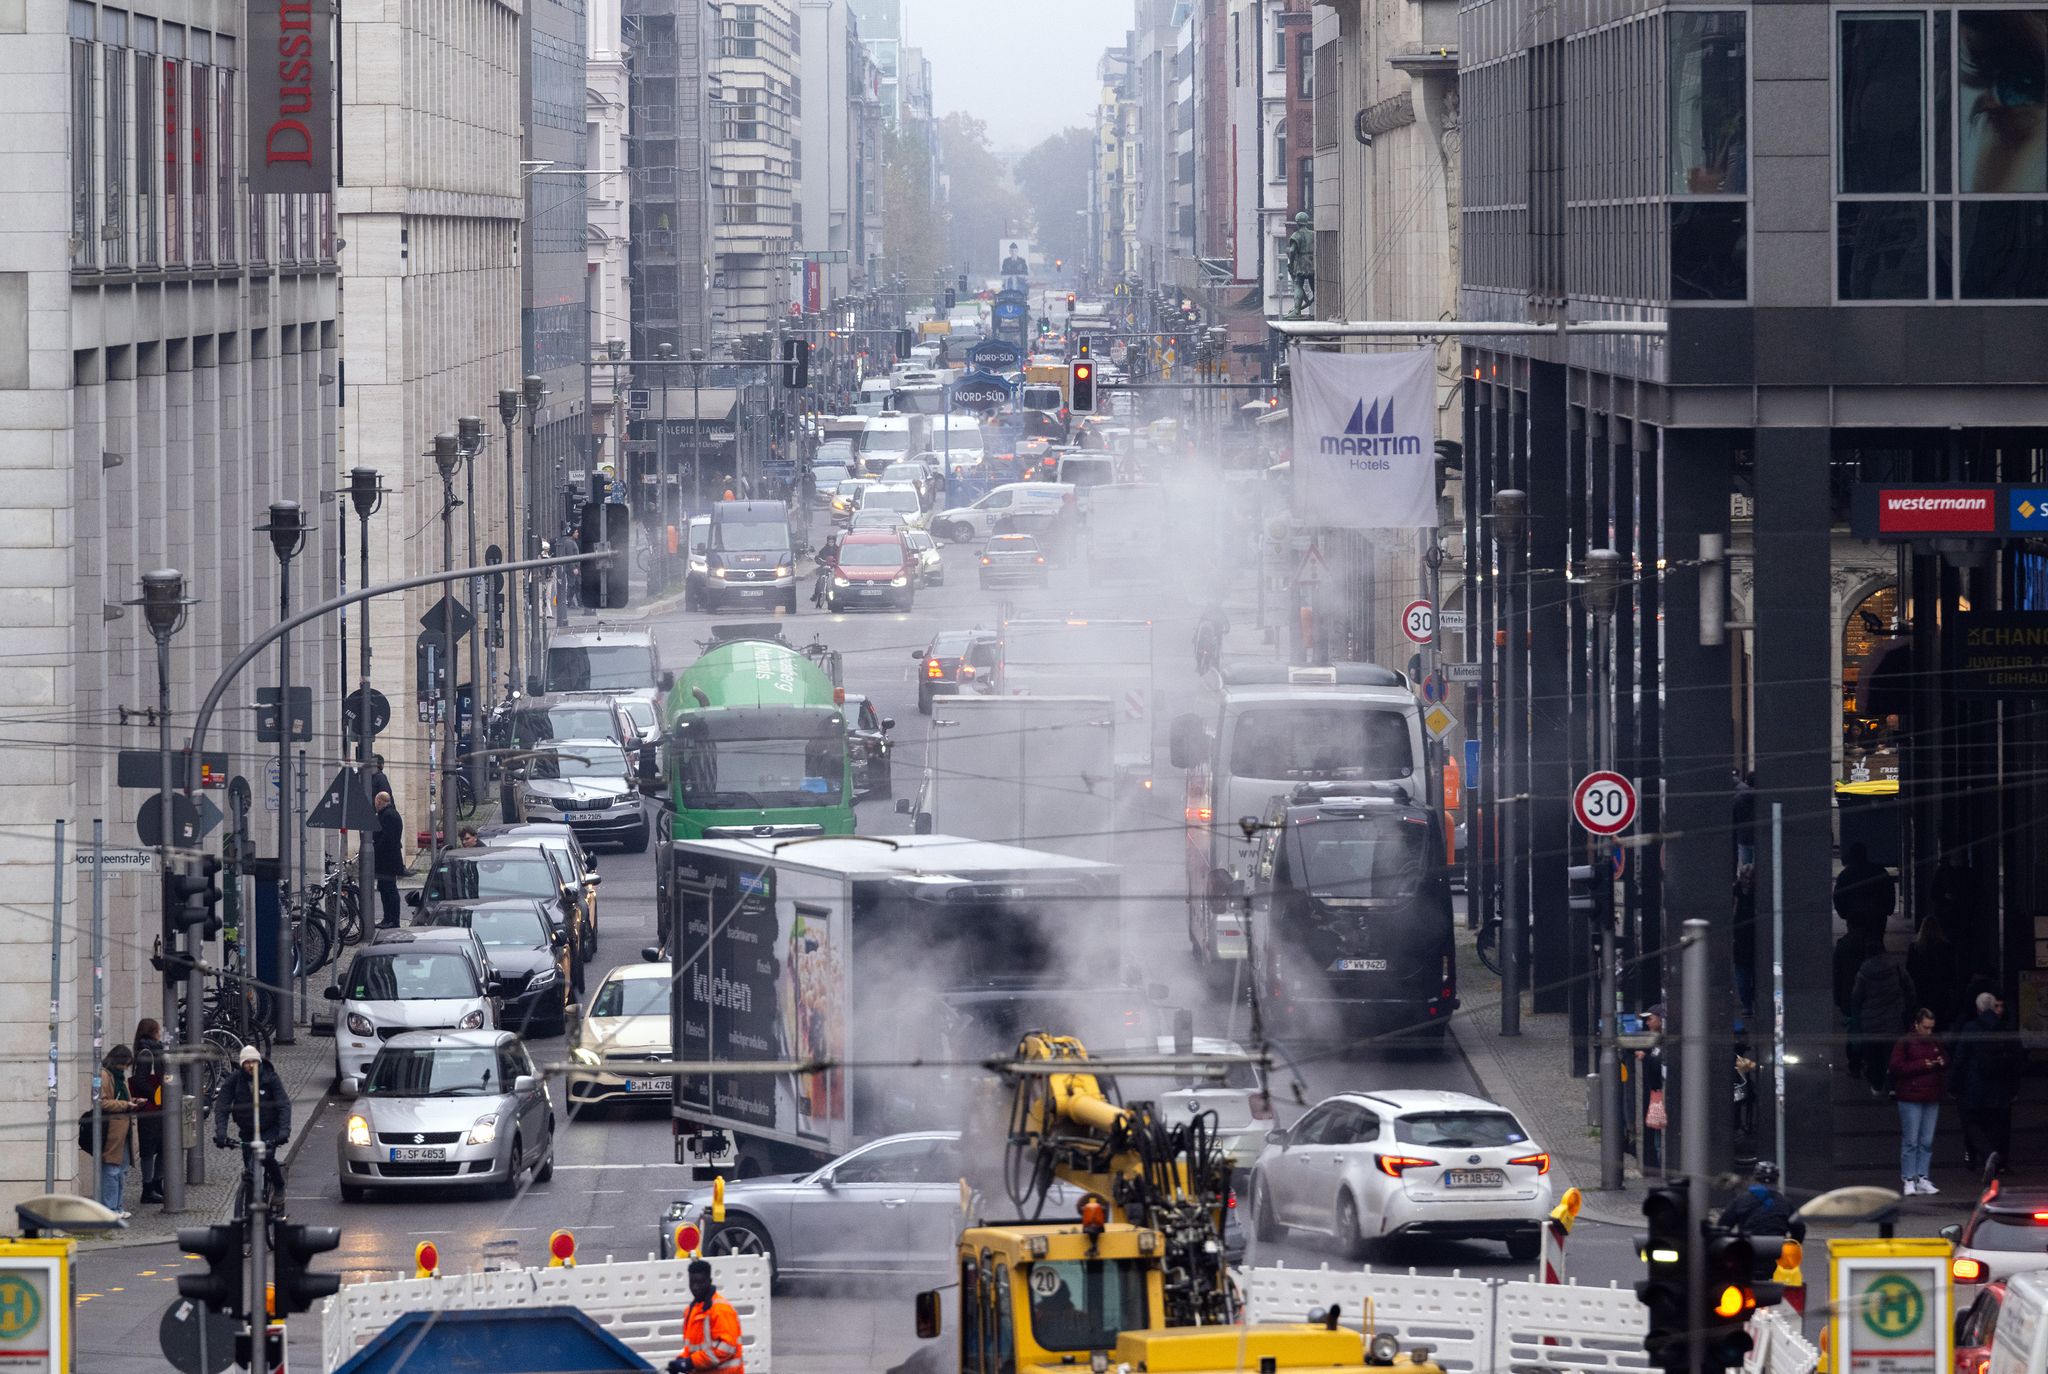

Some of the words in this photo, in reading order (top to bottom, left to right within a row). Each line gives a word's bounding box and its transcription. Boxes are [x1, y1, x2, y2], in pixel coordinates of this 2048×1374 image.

[975, 352, 1014, 362] NORD-SÜD
[955, 388, 1005, 402] NORD-SÜD
[1320, 435, 1420, 456] MARITIM
[1350, 459, 1390, 471] Hotels
[1888, 496, 1986, 511] westermann
[1410, 612, 1432, 632] 30
[464, 697, 471, 708] P
[1588, 790, 1623, 816] 30
[77, 852, 150, 866] oroeenstraße
[694, 962, 752, 1012] kuchen
[641, 1080, 652, 1090] MI
[654, 1080, 673, 1090] 478
[396, 1149, 402, 1159] B
[408, 1149, 419, 1159] SF
[1452, 1174, 1464, 1184] TF
[1470, 1174, 1483, 1184] AB
[1484, 1173, 1501, 1184] 502
[1036, 1271, 1055, 1292] 20
[1878, 1290, 1908, 1325] H
